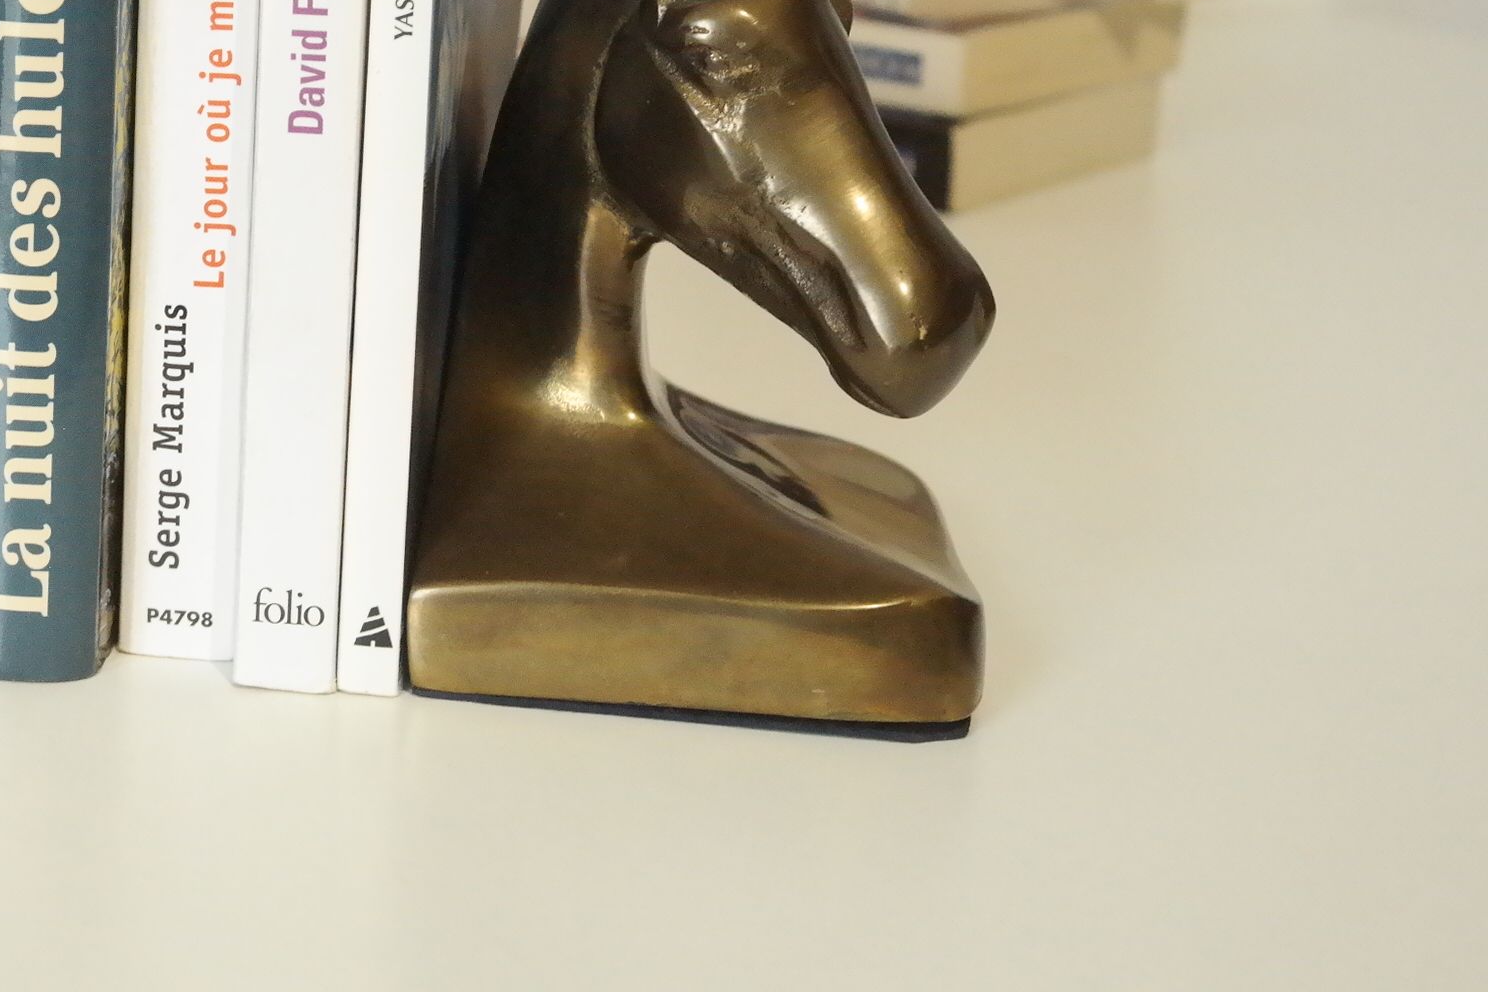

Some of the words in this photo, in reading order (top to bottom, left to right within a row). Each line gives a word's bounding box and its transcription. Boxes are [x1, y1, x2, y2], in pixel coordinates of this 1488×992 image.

[199, 48, 241, 86] je
[287, 29, 328, 136] David
[197, 99, 230, 143] où
[193, 158, 236, 236] jour
[193, 249, 225, 288] Le
[152, 304, 194, 454] Marquis
[148, 469, 190, 569] Serge
[147, 608, 213, 628] P4798
[252, 587, 325, 627] folio
